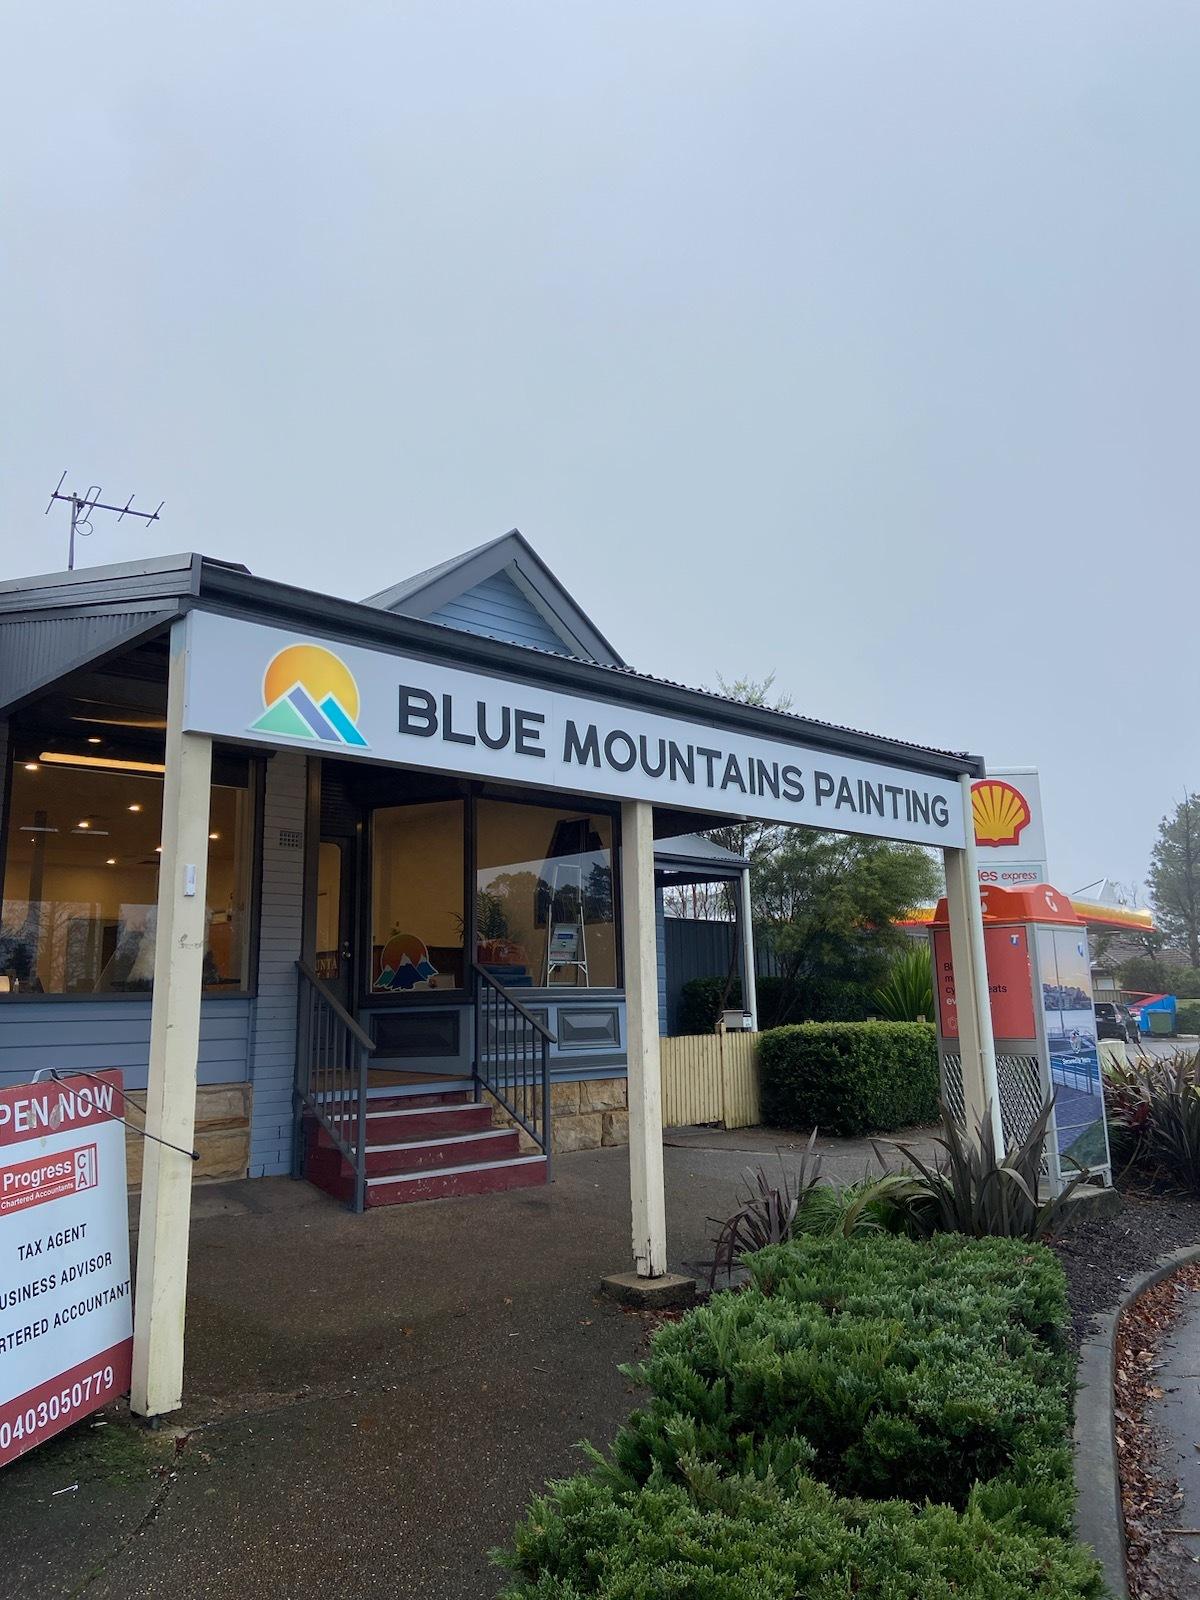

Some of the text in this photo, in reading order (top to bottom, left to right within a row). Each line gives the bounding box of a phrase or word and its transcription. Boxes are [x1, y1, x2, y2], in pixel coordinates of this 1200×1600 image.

[398, 684, 950, 828] BLUE MOUNTAINS PAINTING
[1001, 871, 1038, 883] express
[0, 1083, 114, 1133] PEN NOW
[0, 1182, 75, 1210] Chartered Accountants
[3, 1160, 72, 1192] Progress
[17, 1223, 87, 1261] TAX AGENT
[0, 1251, 113, 1311] USINESS ADVISOR
[53, 1280, 131, 1329] ACCOUNTANT
[0, 1365, 114, 1449] 0403050779
